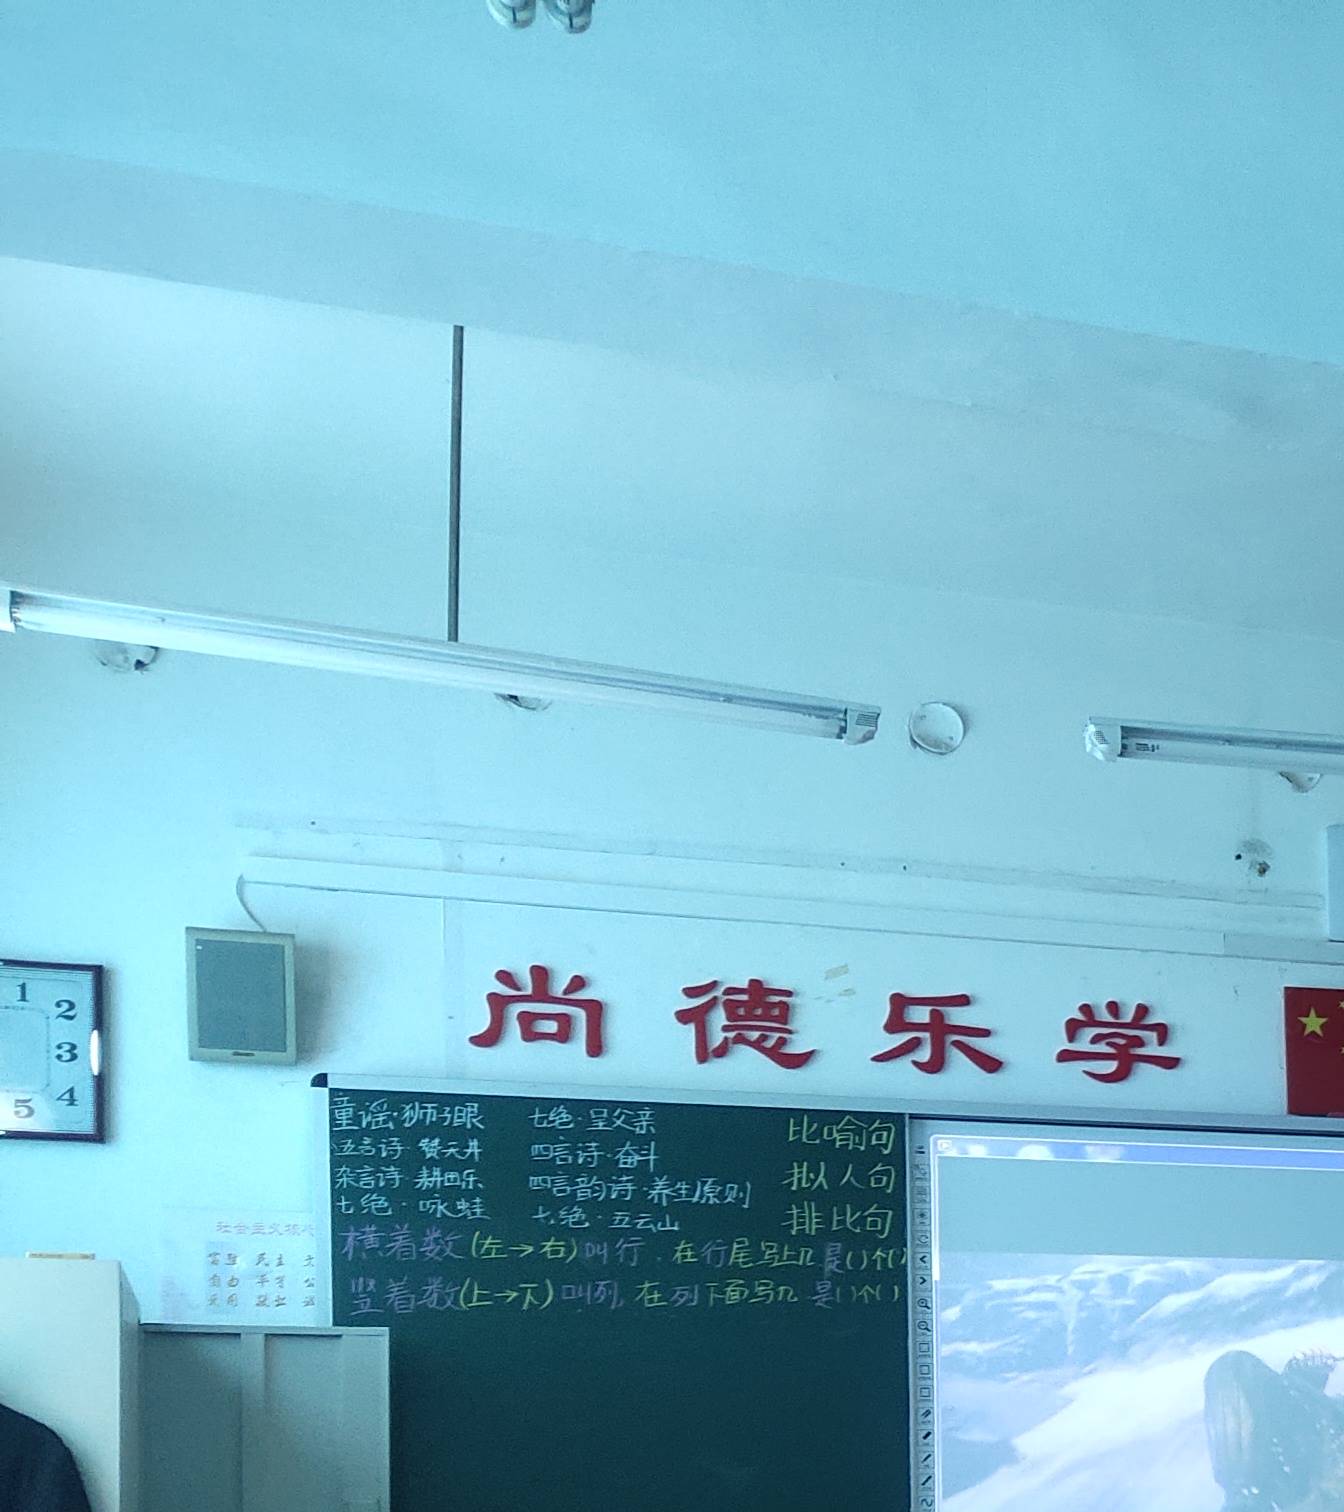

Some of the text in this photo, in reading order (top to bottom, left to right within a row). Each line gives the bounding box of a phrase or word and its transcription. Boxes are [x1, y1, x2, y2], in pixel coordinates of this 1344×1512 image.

[16, 982, 29, 1002] 1
[54, 999, 77, 1021] 2
[470, 965, 1182, 1083] 尚德乐学
[55, 1042, 78, 1062] 3
[56, 1086, 78, 1106] 4
[13, 1098, 35, 1119] 5
[788, 1115, 896, 1154] 比喻句
[782, 1161, 896, 1193] 拟人句
[781, 1201, 893, 1239] 排比句
